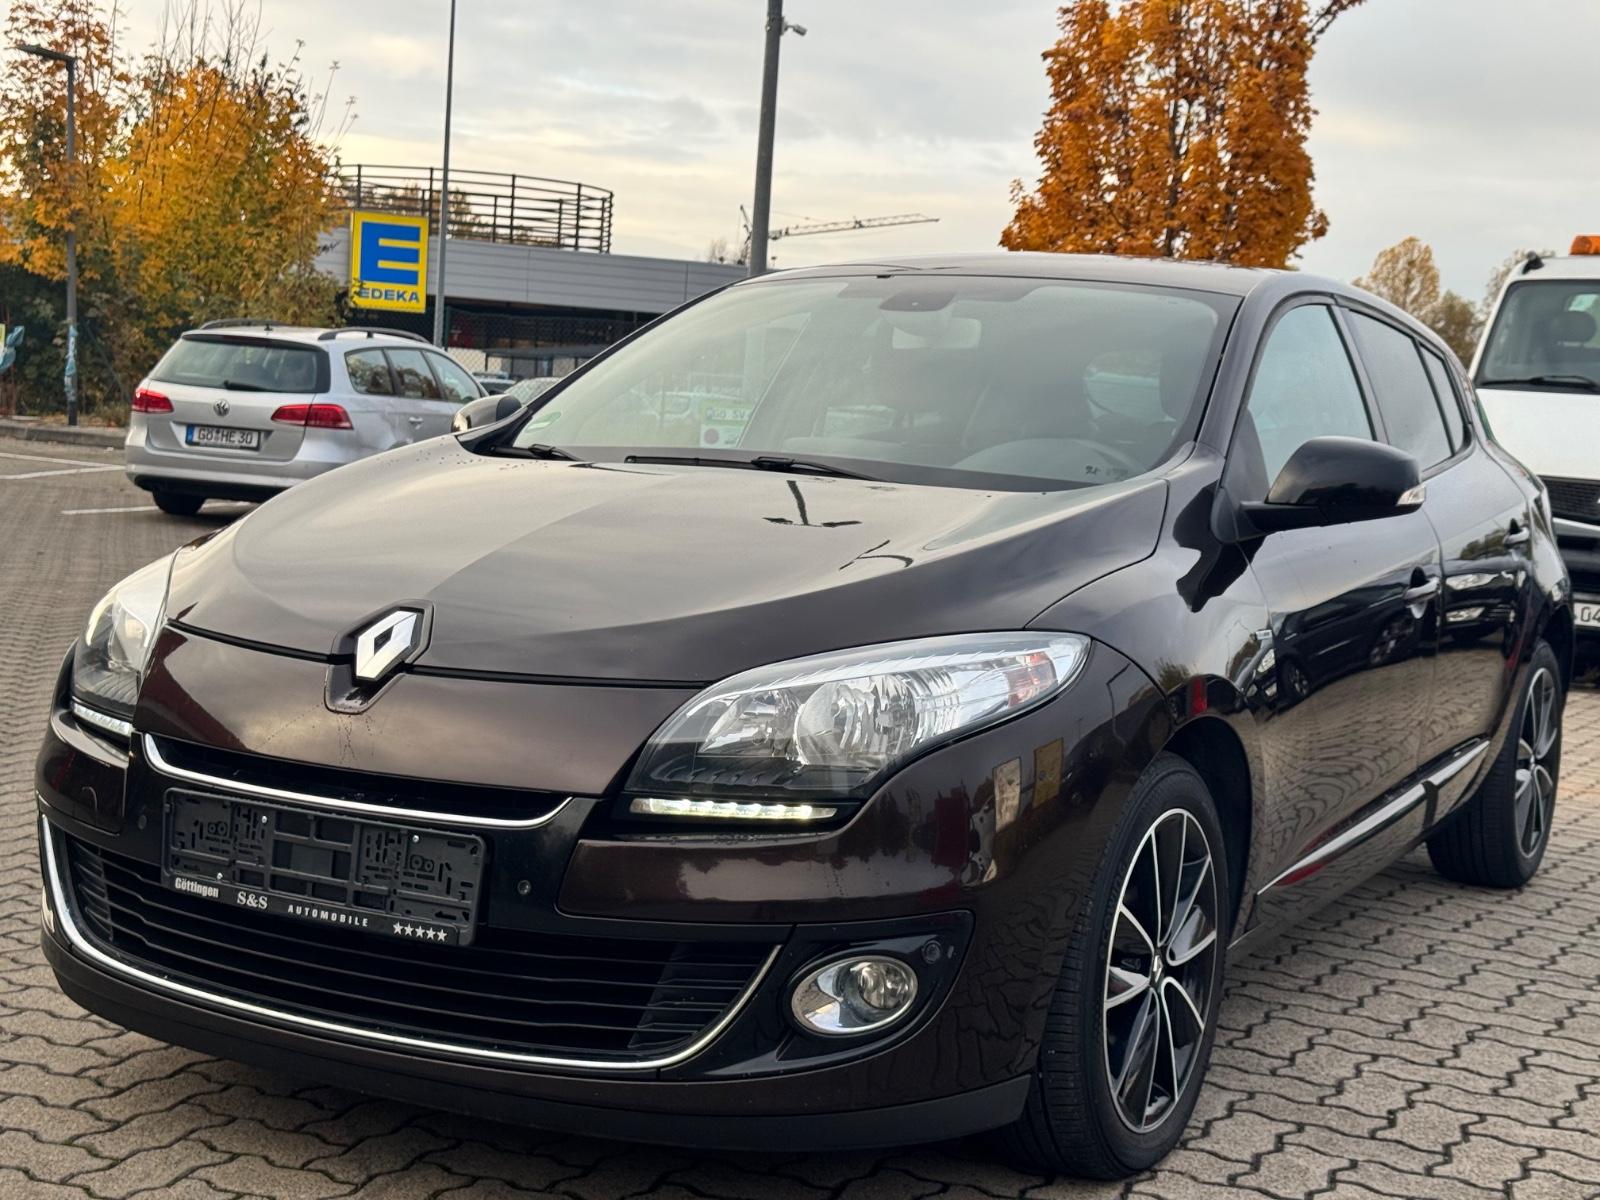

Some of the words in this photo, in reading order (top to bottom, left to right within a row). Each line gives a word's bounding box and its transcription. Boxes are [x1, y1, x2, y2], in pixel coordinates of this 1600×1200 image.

[360, 287, 420, 303] EDEKA
[221, 430, 236, 443] HE
[238, 431, 253, 445] 30
[174, 877, 220, 898] Göttingen
[236, 890, 268, 910] S&S
[287, 904, 369, 928] AUTOMOBILE
